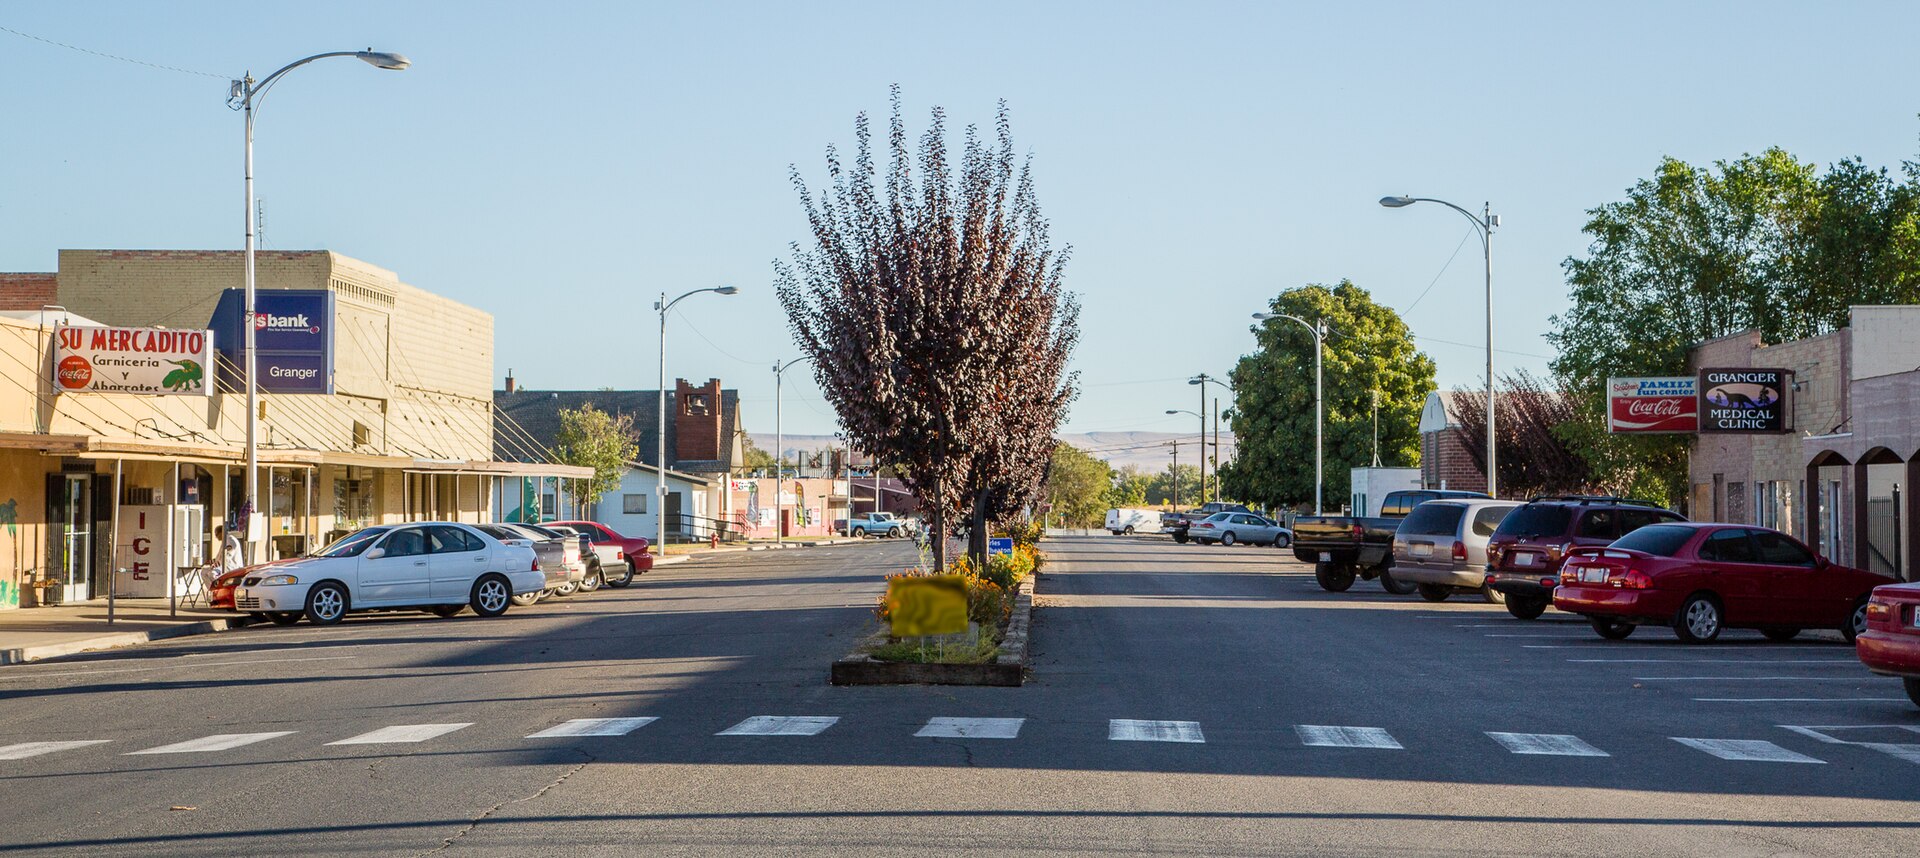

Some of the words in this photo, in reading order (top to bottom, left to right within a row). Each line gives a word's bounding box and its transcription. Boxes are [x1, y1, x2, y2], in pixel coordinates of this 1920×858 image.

[59, 328, 83, 350] SU
[90, 329, 203, 355] MERCADITO
[92, 354, 160, 367] Carniceria
[121, 371, 129, 380] Y
[270, 366, 318, 380] Granger
[1708, 373, 1776, 382] GRANGER
[1637, 387, 1657, 395] fun
[1629, 399, 1682, 416] Coca-Cola
[1710, 409, 1774, 419] MEDICAL
[1718, 419, 1766, 429] CLINIC
[132, 511, 151, 581] ICE
